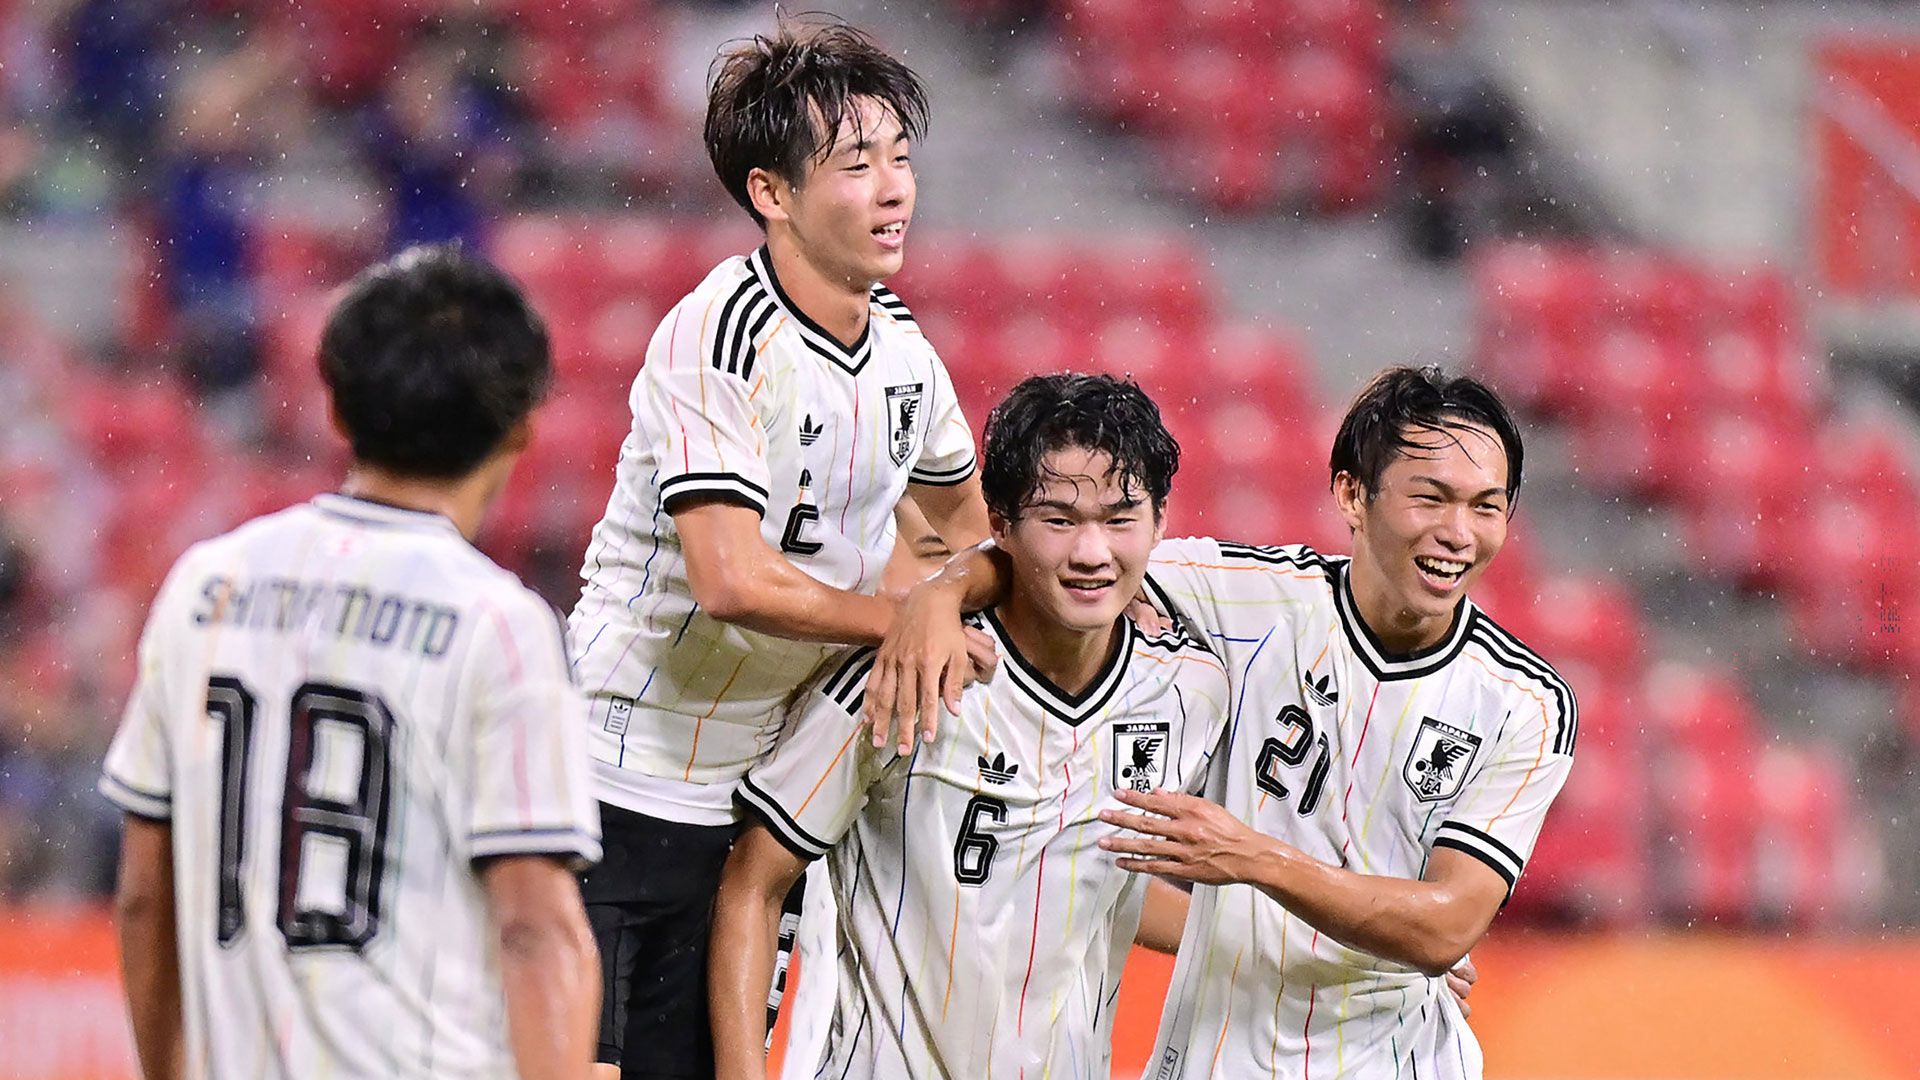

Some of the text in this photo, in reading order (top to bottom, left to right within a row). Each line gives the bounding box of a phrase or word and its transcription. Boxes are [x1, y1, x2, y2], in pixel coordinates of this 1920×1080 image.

[1126, 724, 1158, 733] JAPAN
[1435, 722, 1469, 741] JAPAN
[1254, 703, 1331, 818] 21
[1130, 778, 1151, 792] JFA
[1415, 774, 1442, 795] JFA
[205, 676, 395, 948] 18
[953, 794, 1008, 888] 6
